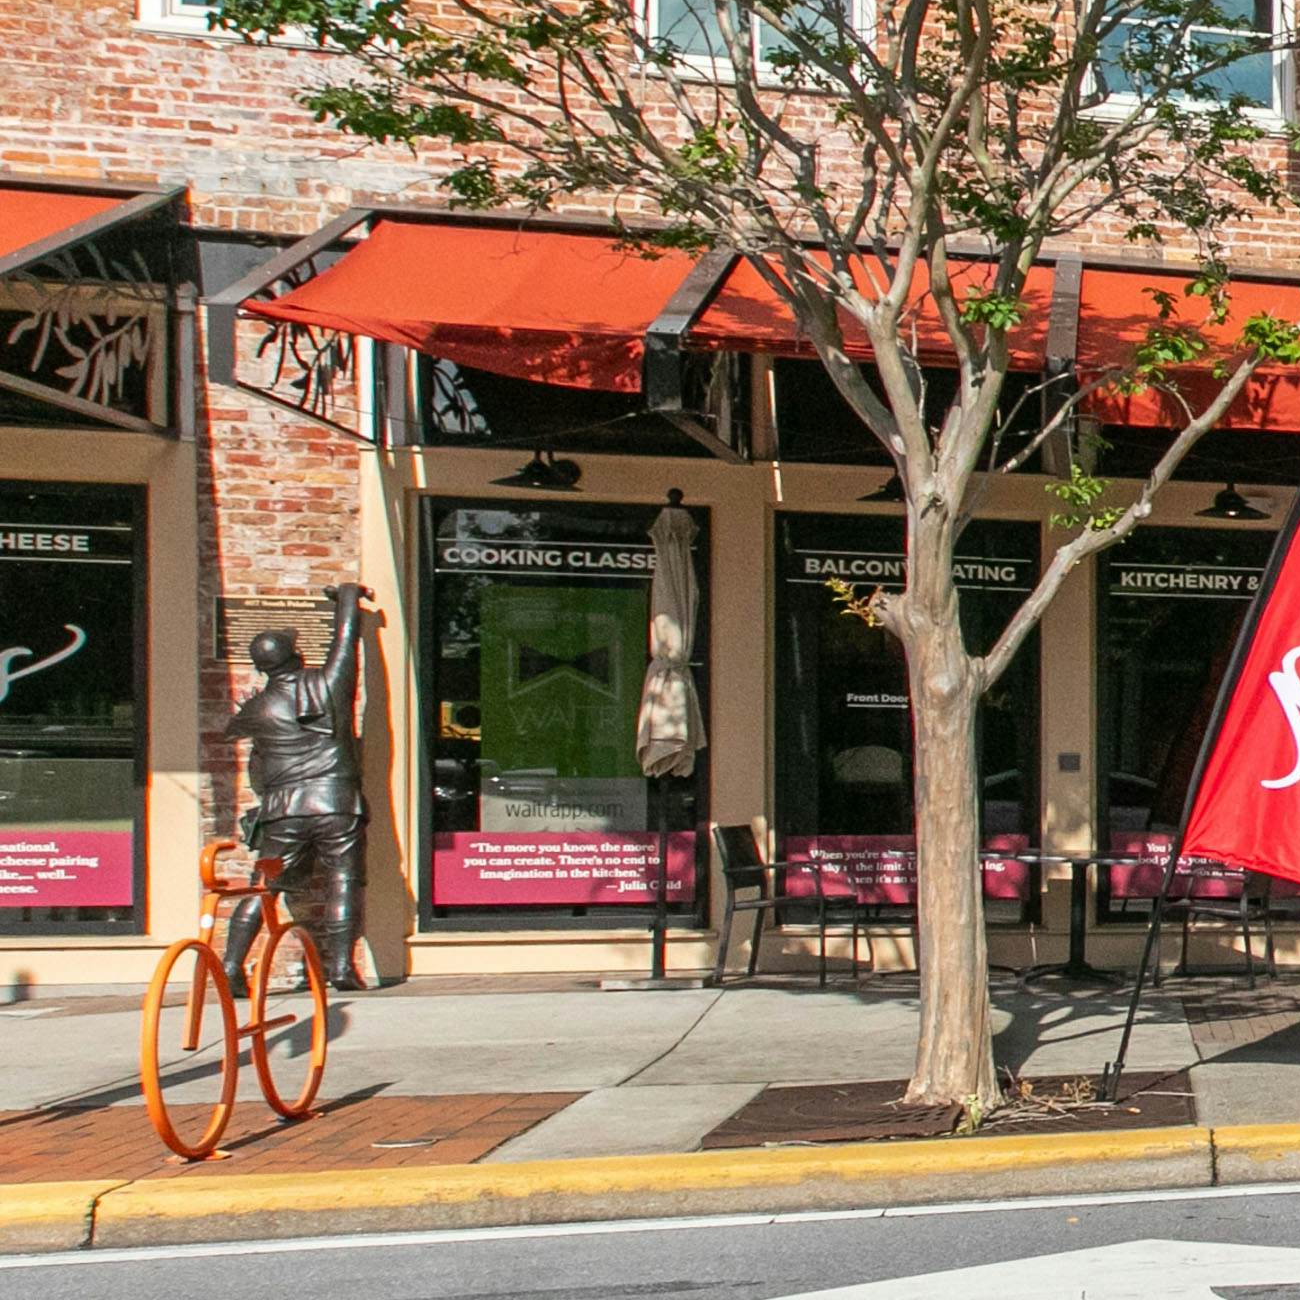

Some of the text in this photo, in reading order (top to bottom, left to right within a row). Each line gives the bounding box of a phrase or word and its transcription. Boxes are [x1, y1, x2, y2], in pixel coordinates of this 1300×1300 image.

[0, 532, 90, 552] HEESE
[443, 547, 658, 570] COOKING CLASSE
[952, 564, 1017, 582] ATING
[1121, 571, 1260, 591] KITCHENRY &
[846, 693, 909, 703] Front Door
[505, 801, 623, 820] waitrapp.com
[0, 842, 59, 853] sational,
[504, 844, 537, 853] more
[538, 845, 561, 855] you
[563, 842, 599, 854] know,
[600, 843, 621, 853] the
[623, 844, 656, 853] more
[1146, 843, 1166, 853] You
[809, 849, 843, 860] When
[1139, 855, 1158, 864] ood
[1188, 857, 1207, 866] you
[48, 855, 99, 868] pairing
[463, 857, 487, 868] you
[489, 857, 512, 866] can
[514, 856, 556, 867] create.
[605, 857, 621, 865] no
[623, 855, 646, 866] end
[648, 856, 661, 866] to
[822, 862, 841, 874] sky
[855, 862, 874, 872] the
[876, 862, 905, 872] limit.
[480, 869, 553, 881] imagination
[555, 869, 568, 879] in
[570, 868, 590, 879] the
[618, 880, 647, 893] Julia
[650, 881, 682, 890] Cild
